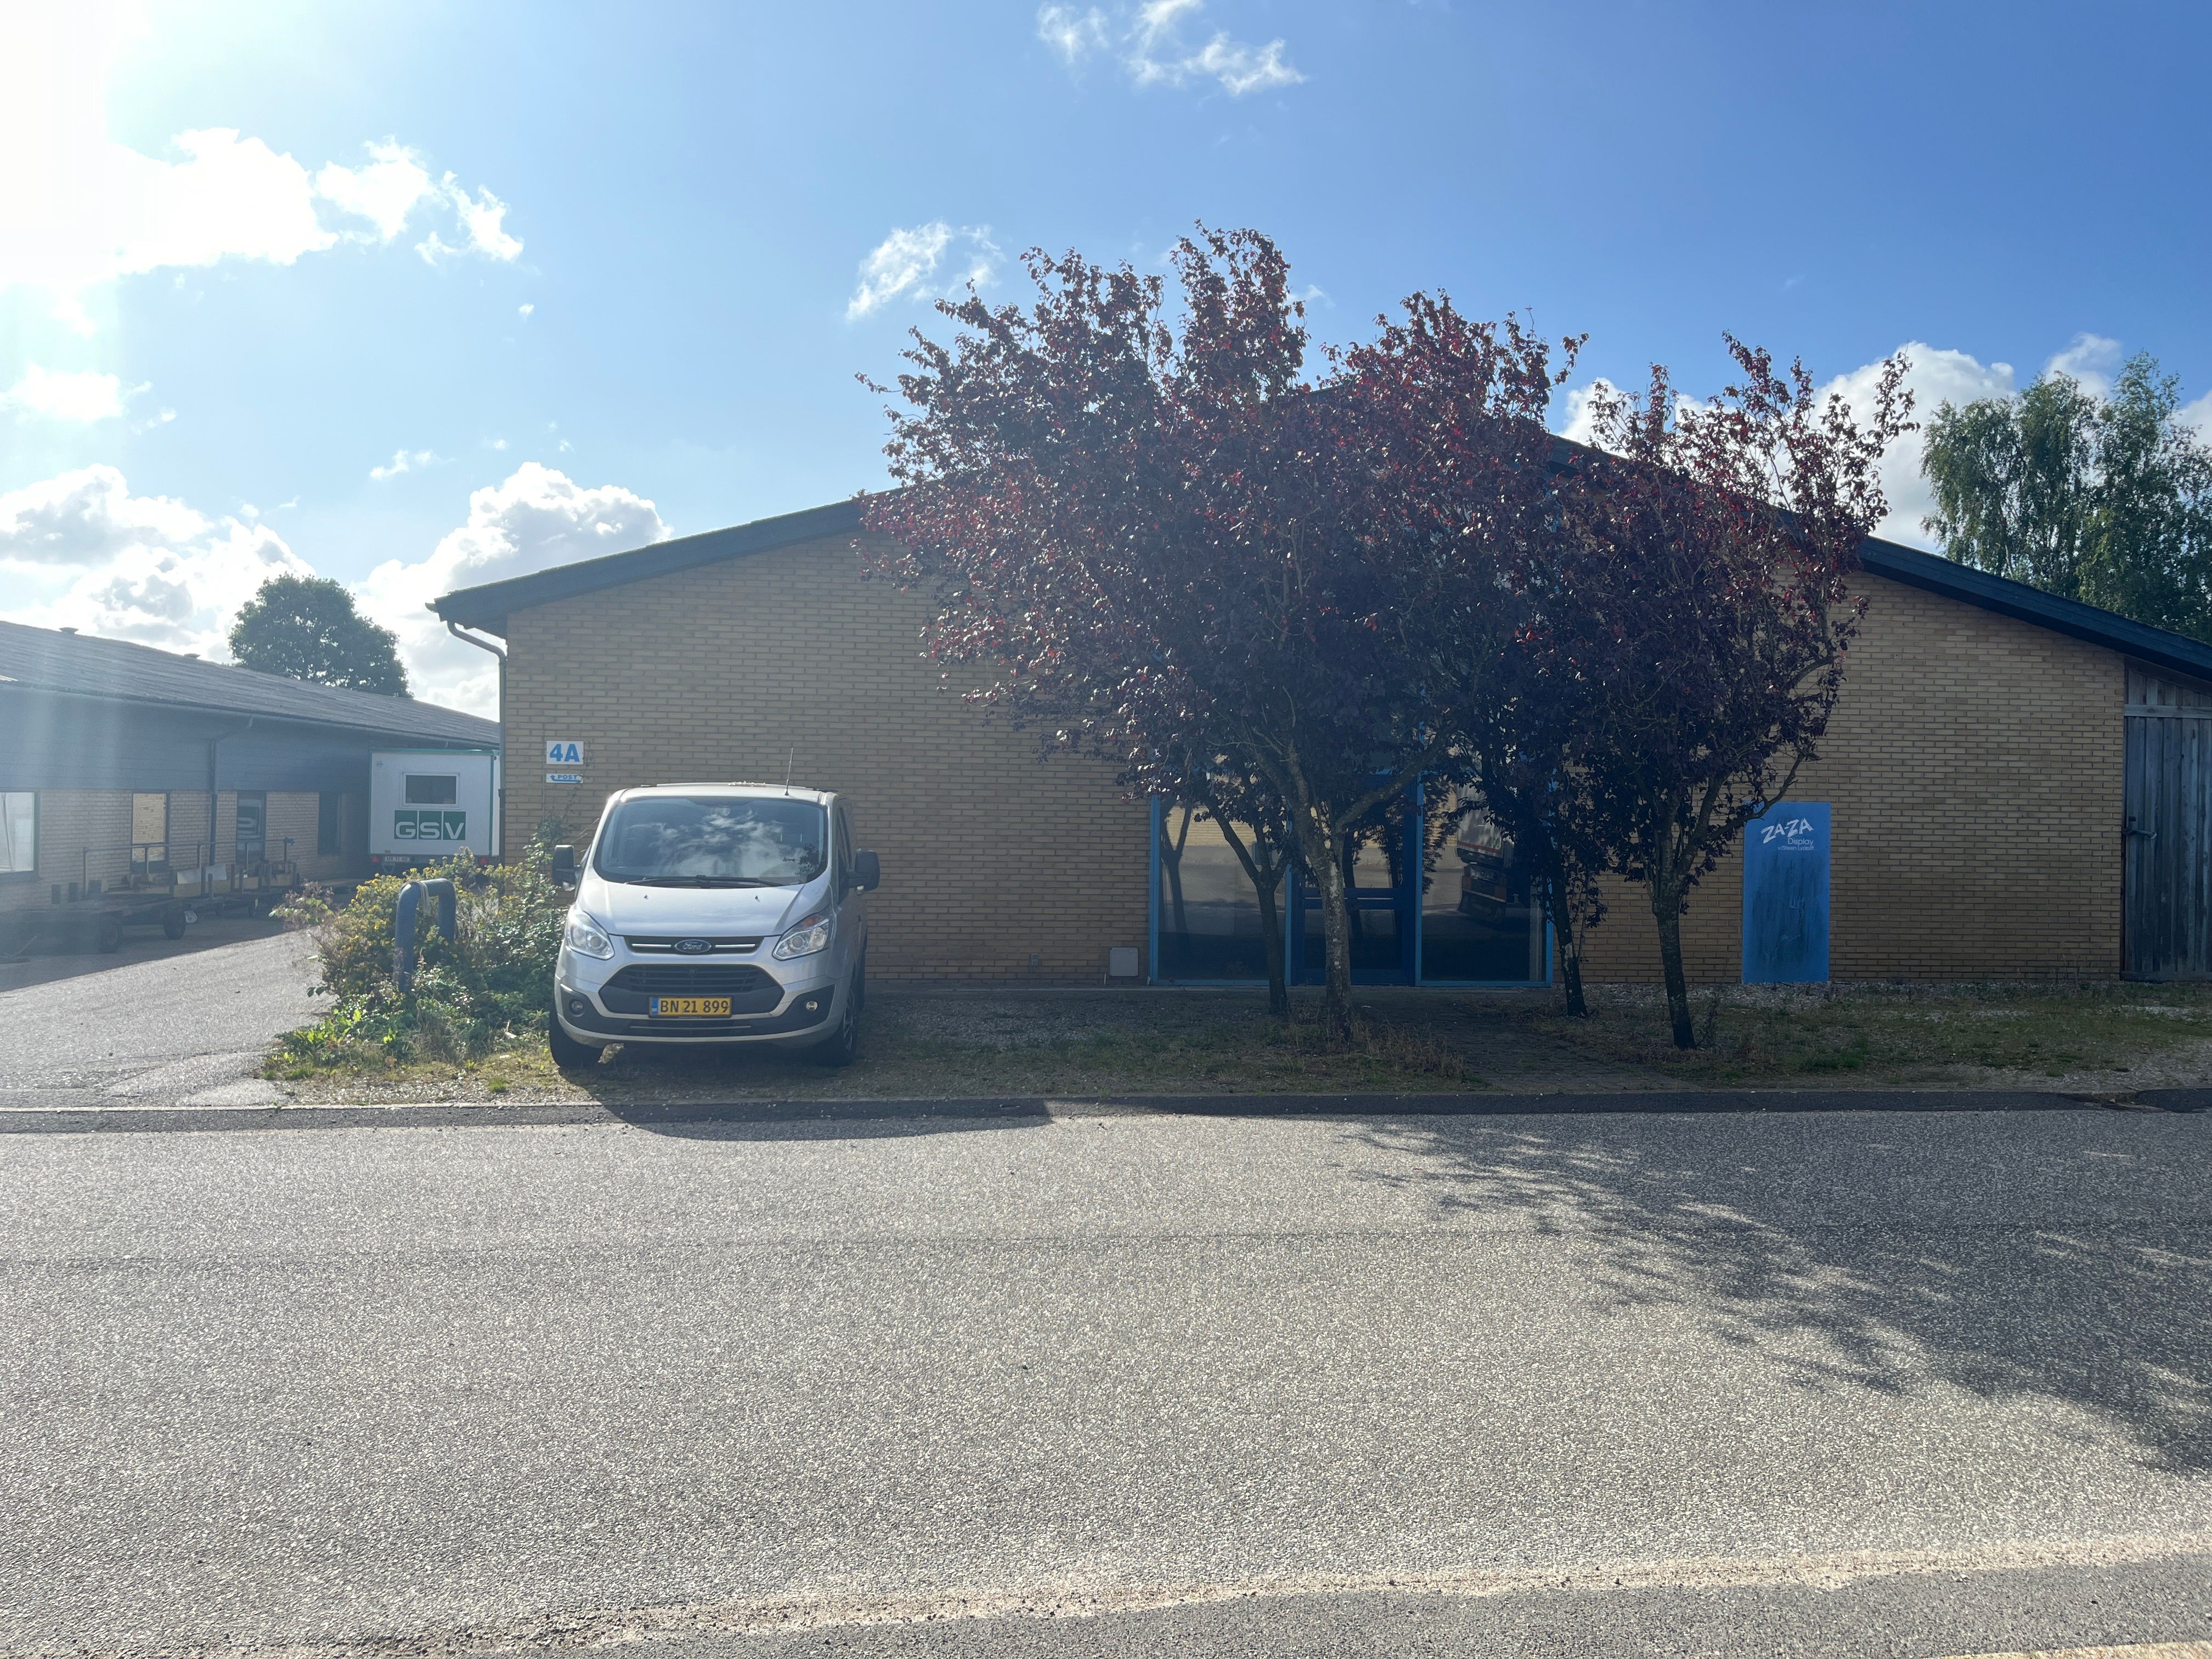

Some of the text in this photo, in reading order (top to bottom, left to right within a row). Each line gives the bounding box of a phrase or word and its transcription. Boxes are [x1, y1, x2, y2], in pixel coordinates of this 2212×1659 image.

[550, 743, 580, 762] 4A
[396, 821, 465, 839] GSV
[1760, 817, 1814, 844] ZA-ZA
[1788, 838, 1814, 846] Display
[682, 941, 703, 950] Ford
[661, 1000, 679, 1013] BN
[682, 1000, 698, 1013] 21
[703, 1000, 729, 1013] 899
